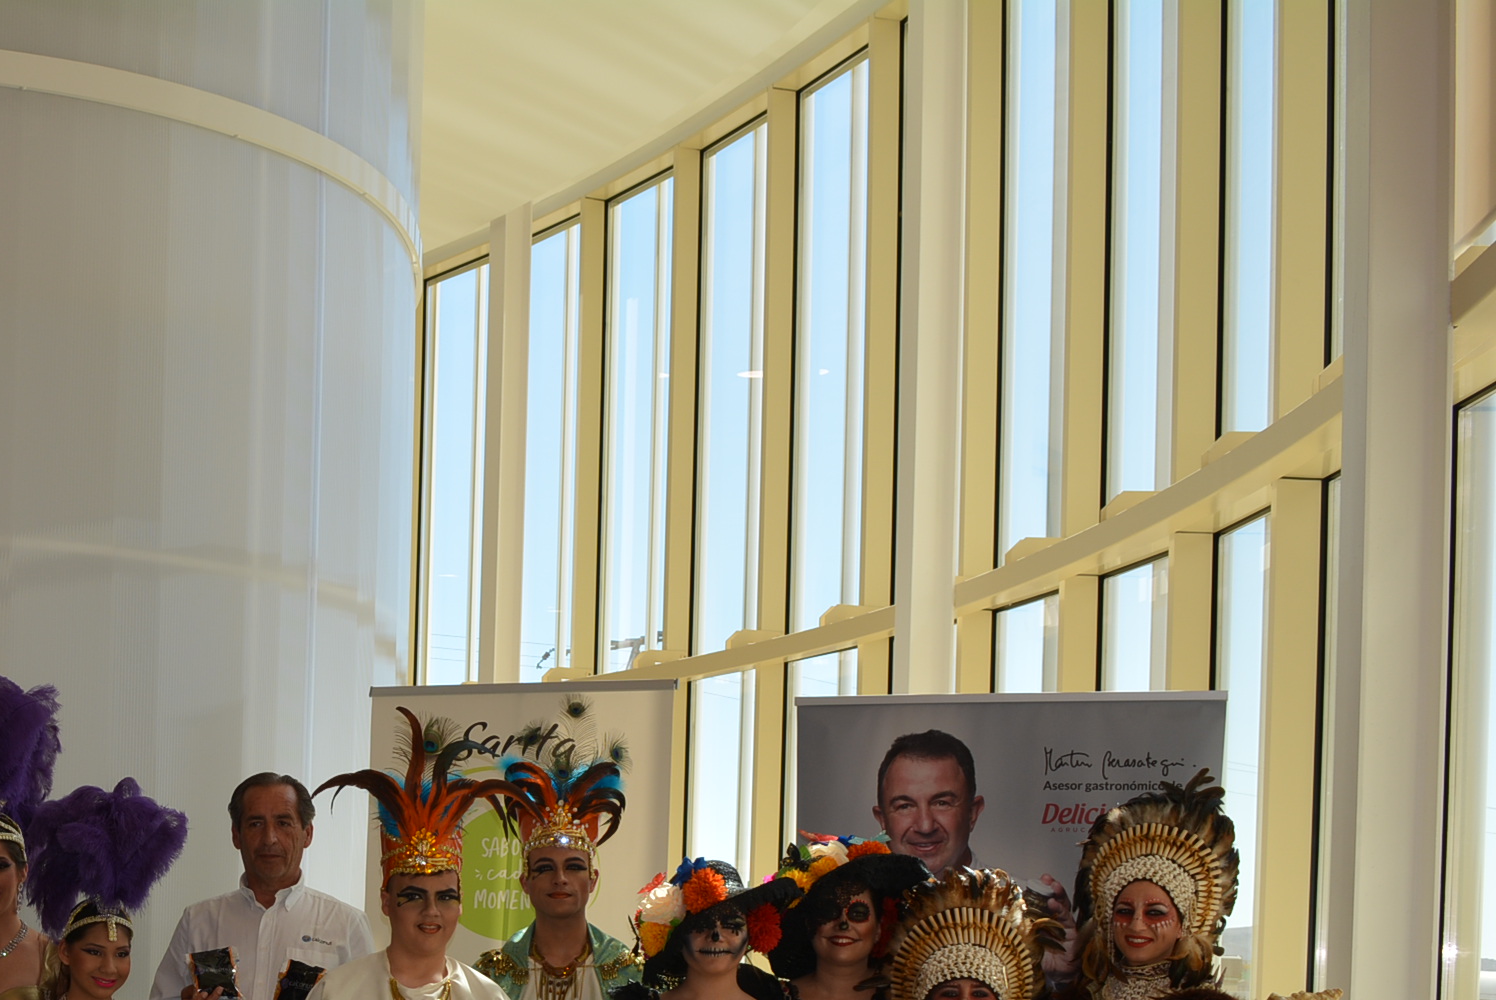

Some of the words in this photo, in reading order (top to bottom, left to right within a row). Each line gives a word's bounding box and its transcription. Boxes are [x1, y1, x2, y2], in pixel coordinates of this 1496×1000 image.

[454, 721, 576, 761] Sarita
[1043, 781, 1081, 791] Asesor
[481, 836, 522, 858] SABO
[487, 857, 523, 880] cad
[474, 889, 531, 911] MOMEN
